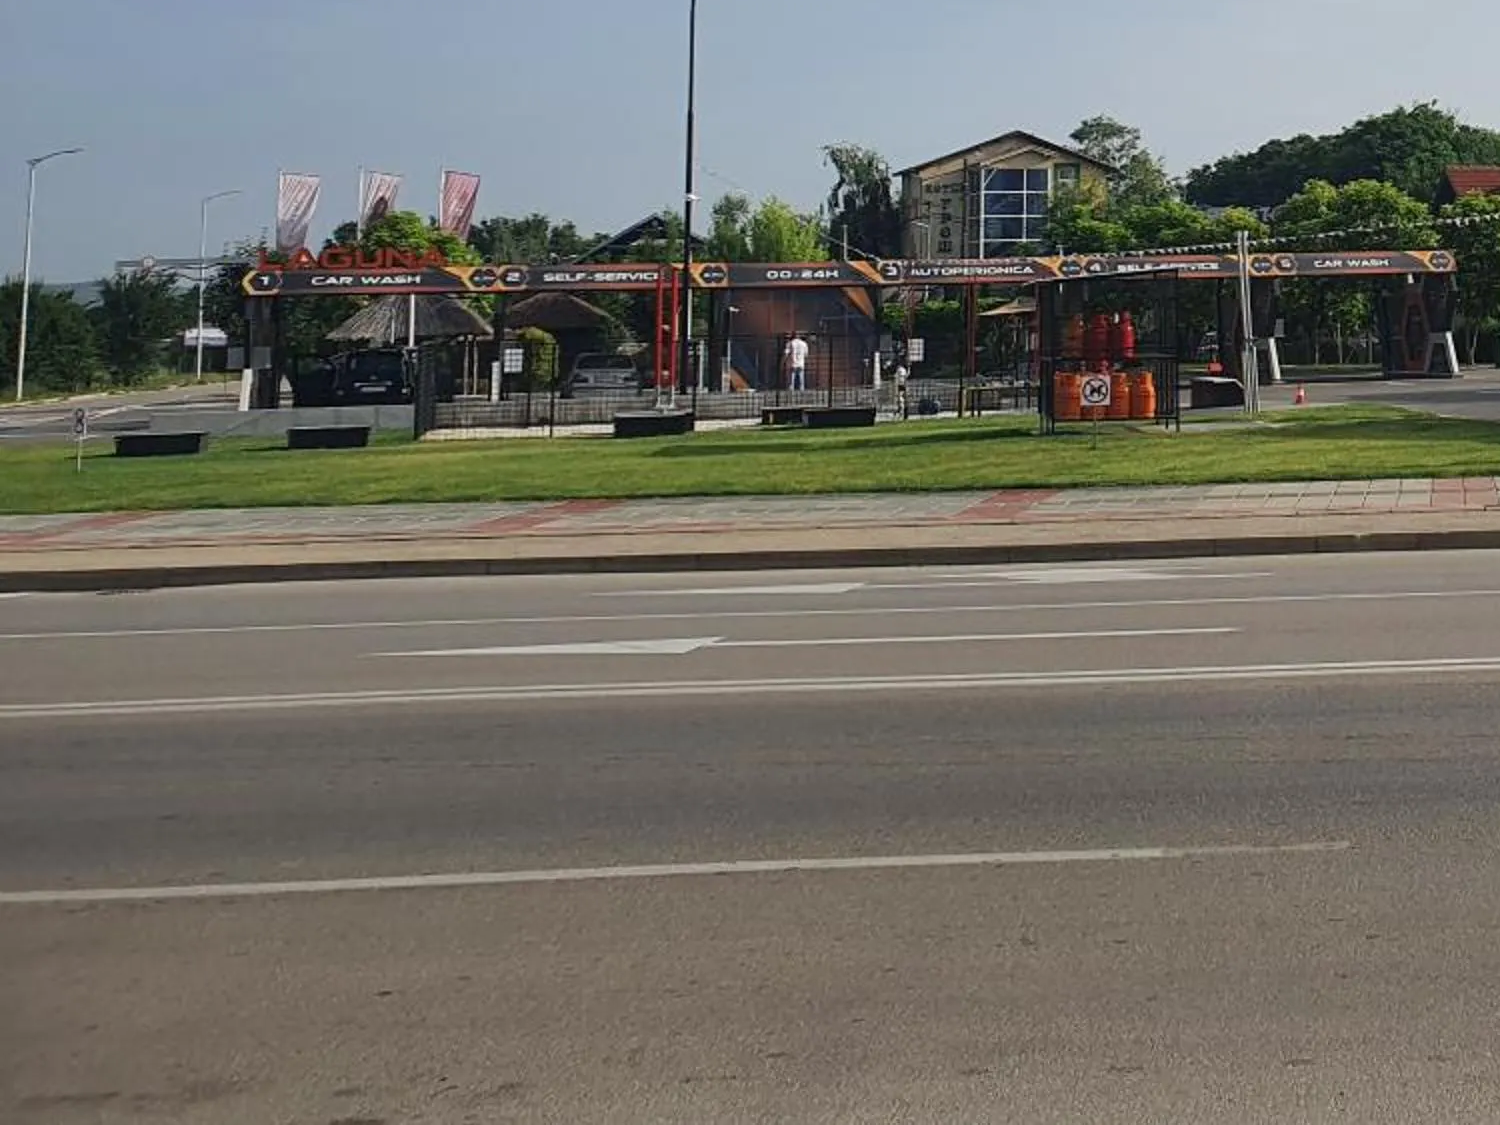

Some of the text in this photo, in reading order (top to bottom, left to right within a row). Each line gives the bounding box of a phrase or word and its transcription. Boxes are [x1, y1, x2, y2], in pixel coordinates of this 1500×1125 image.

[257, 247, 449, 270] LAGUNA
[1313, 258, 1391, 268] CAR WASH
[885, 266, 897, 275] 3
[911, 265, 1035, 276] AUTOPERIONICA
[1116, 262, 1220, 273] SELFSERVICE
[260, 276, 269, 286] 1
[312, 275, 421, 286] CAR WASH
[506, 272, 520, 282] 2
